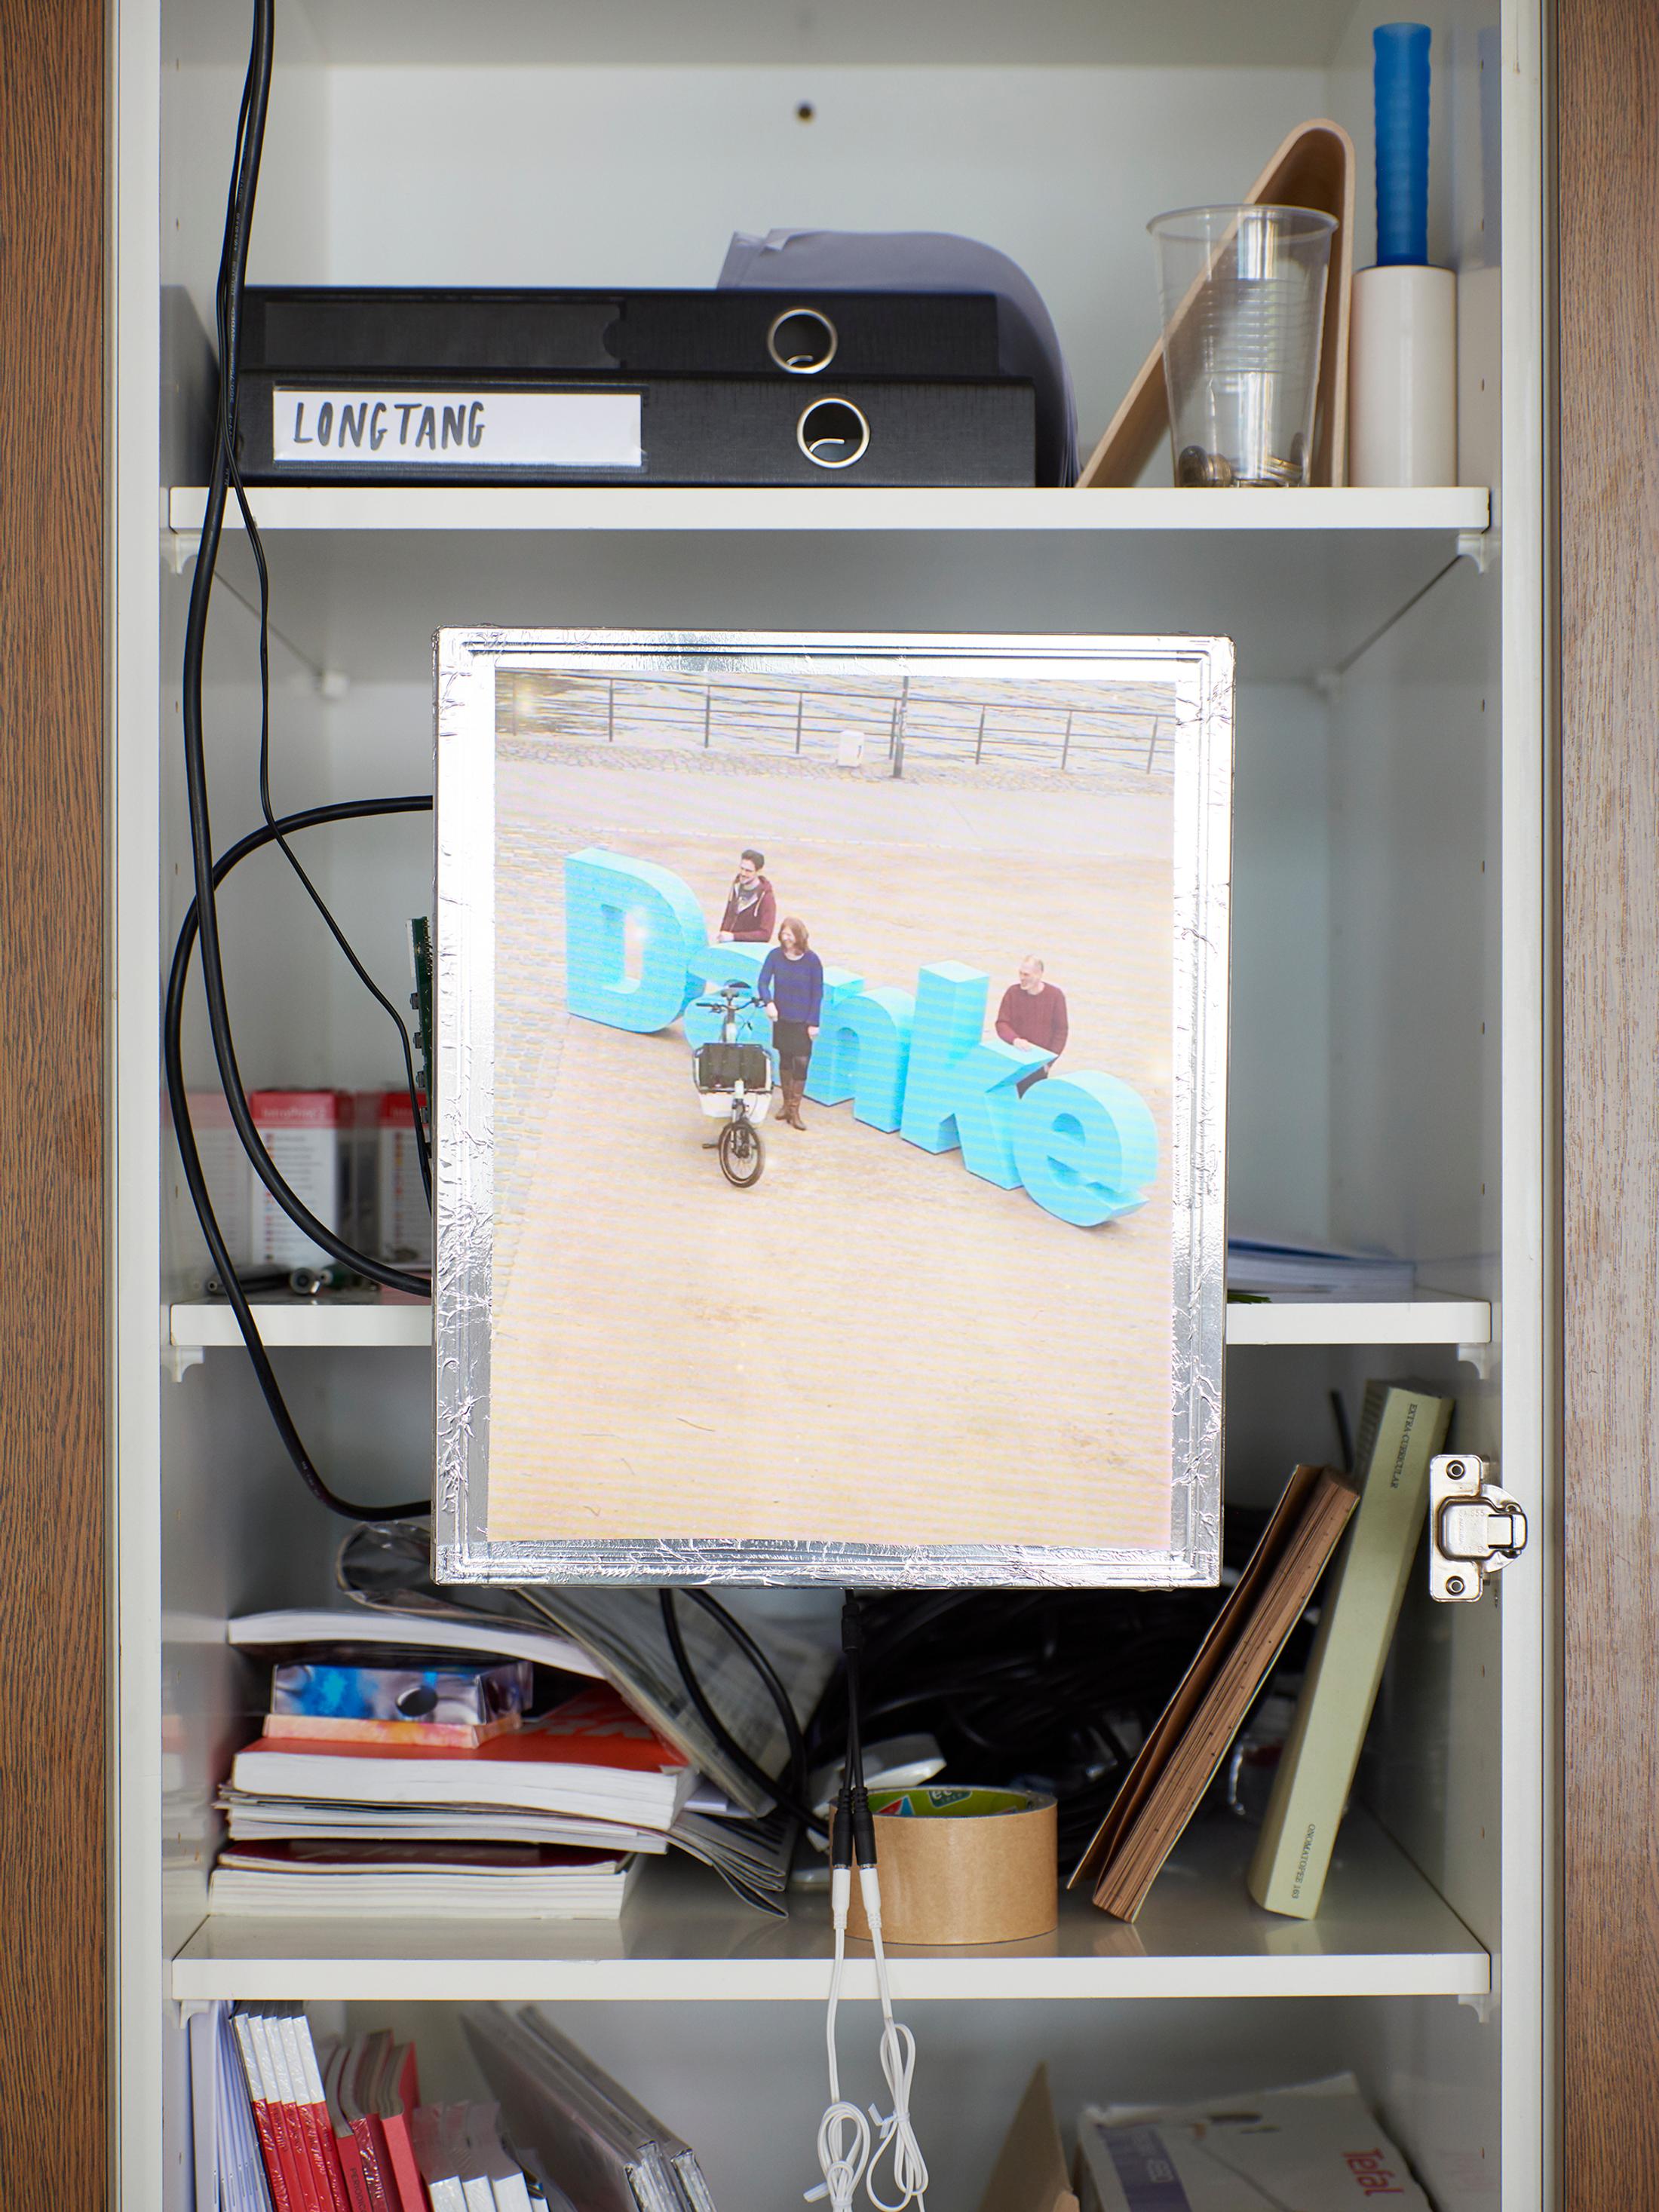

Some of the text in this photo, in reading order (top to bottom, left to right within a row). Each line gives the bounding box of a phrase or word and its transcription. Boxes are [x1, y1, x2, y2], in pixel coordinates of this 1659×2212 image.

[293, 401, 486, 451] LONGTANG
[565, 847, 1158, 1227] Danke
[1291, 1824, 1316, 1899] ONOMATOPEE 163
[1340, 2147, 1405, 2197] Tefal
